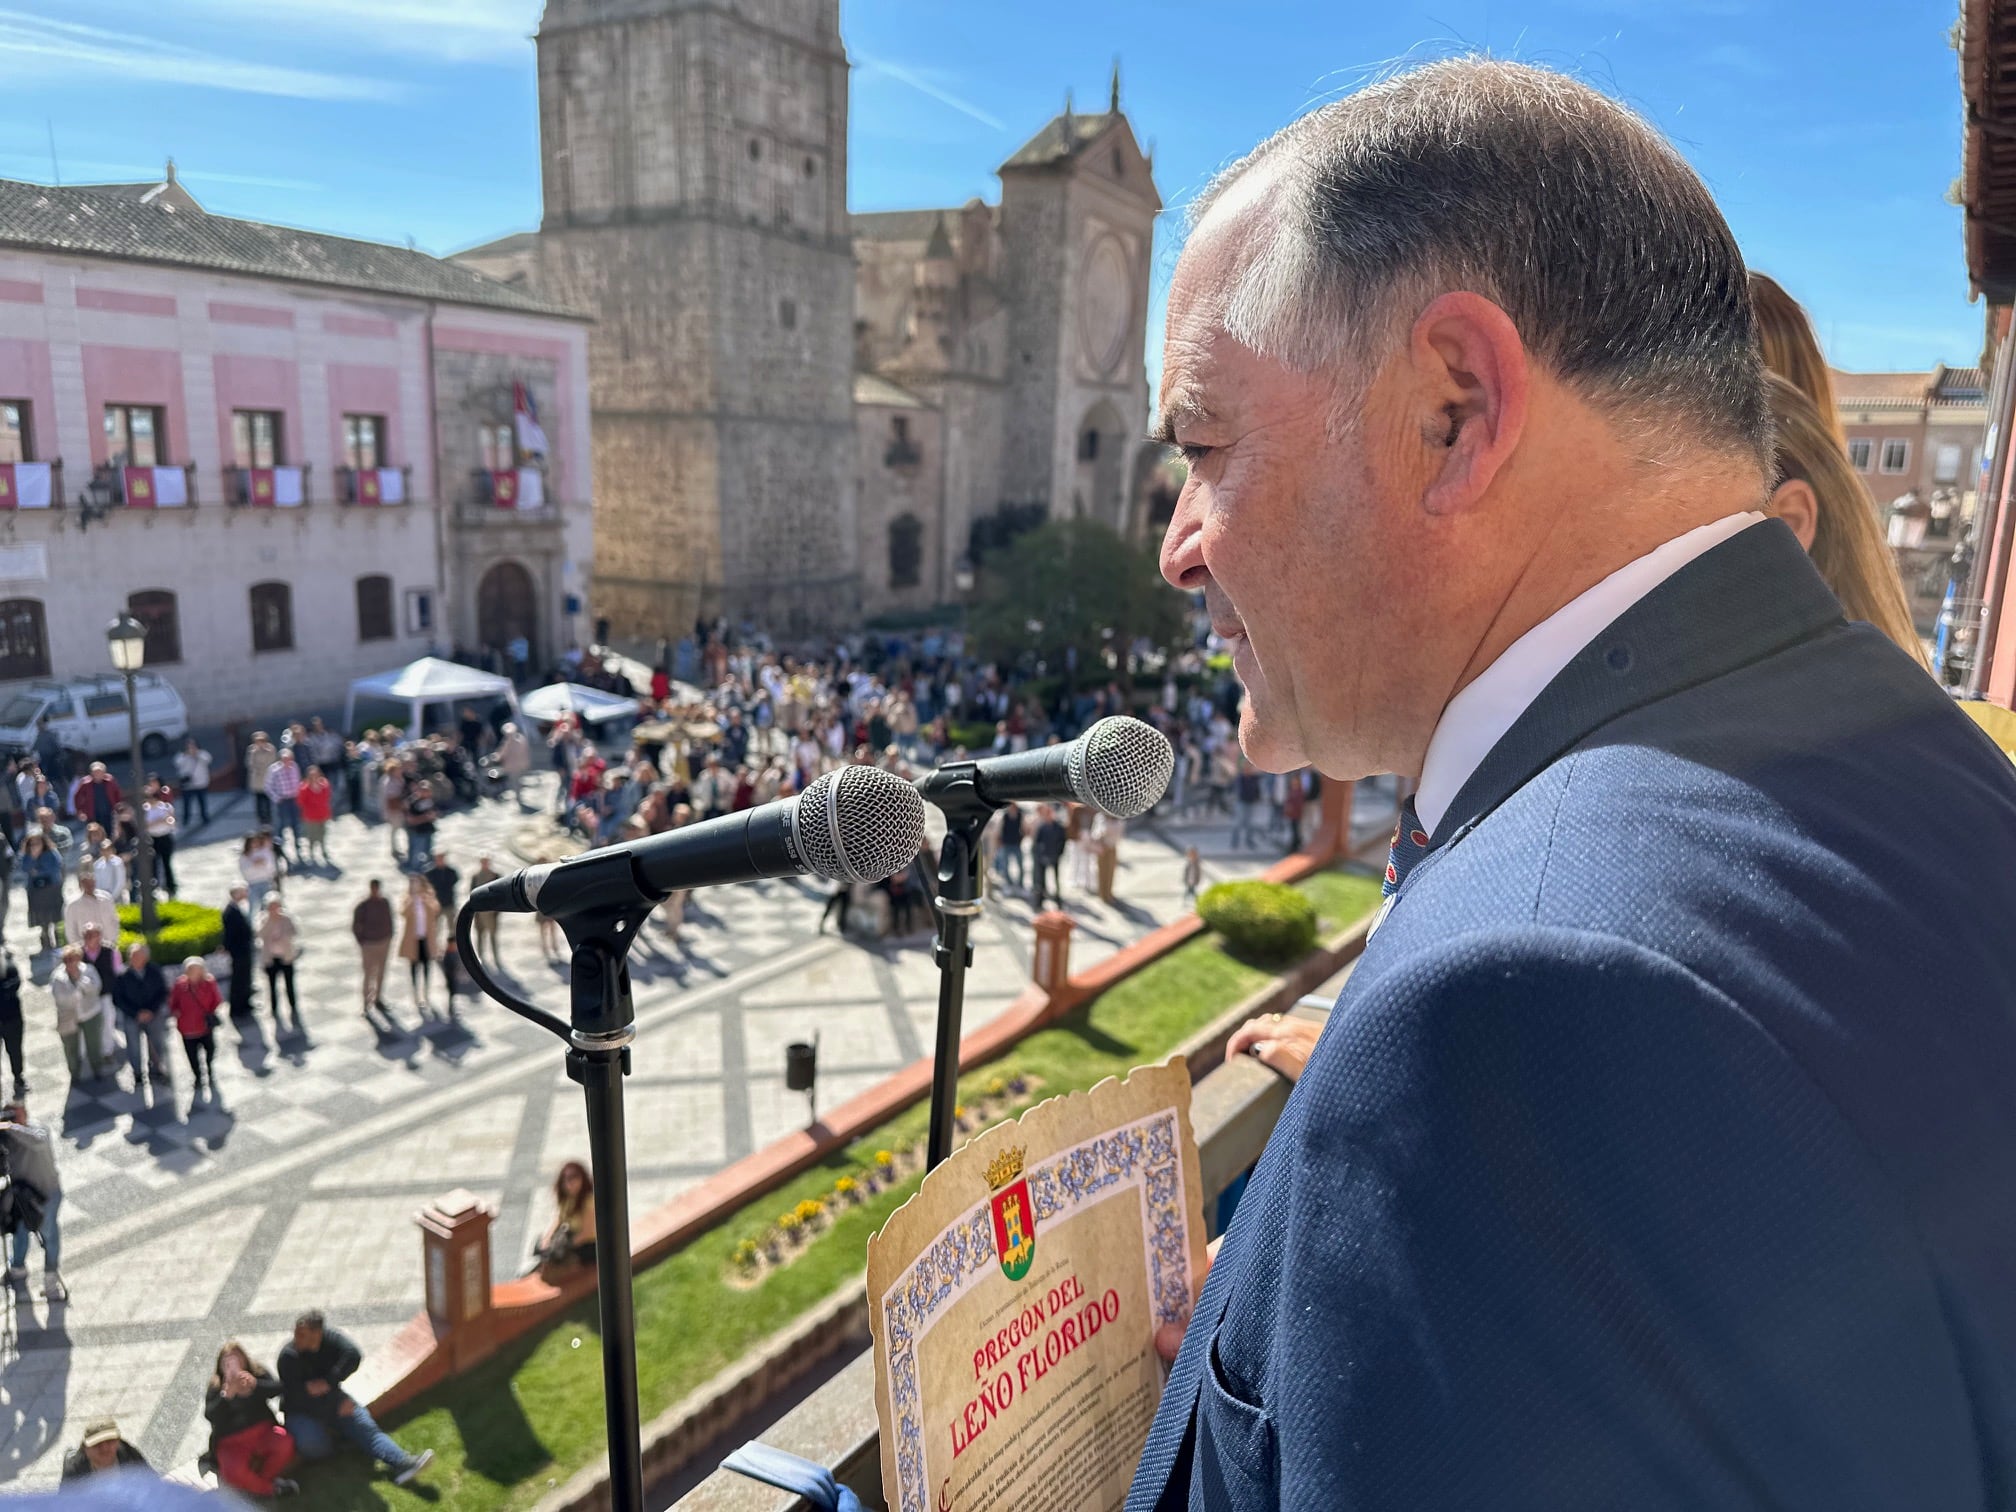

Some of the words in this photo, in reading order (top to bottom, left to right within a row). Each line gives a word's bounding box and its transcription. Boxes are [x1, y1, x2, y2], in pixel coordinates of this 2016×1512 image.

[784, 836, 798, 860] SM58
[950, 1371, 1014, 1459] LEÑO
[1017, 1288, 1120, 1394] FLORIDO
[973, 1299, 1046, 1381] PREGÓN
[1047, 1275, 1085, 1317] DEL
